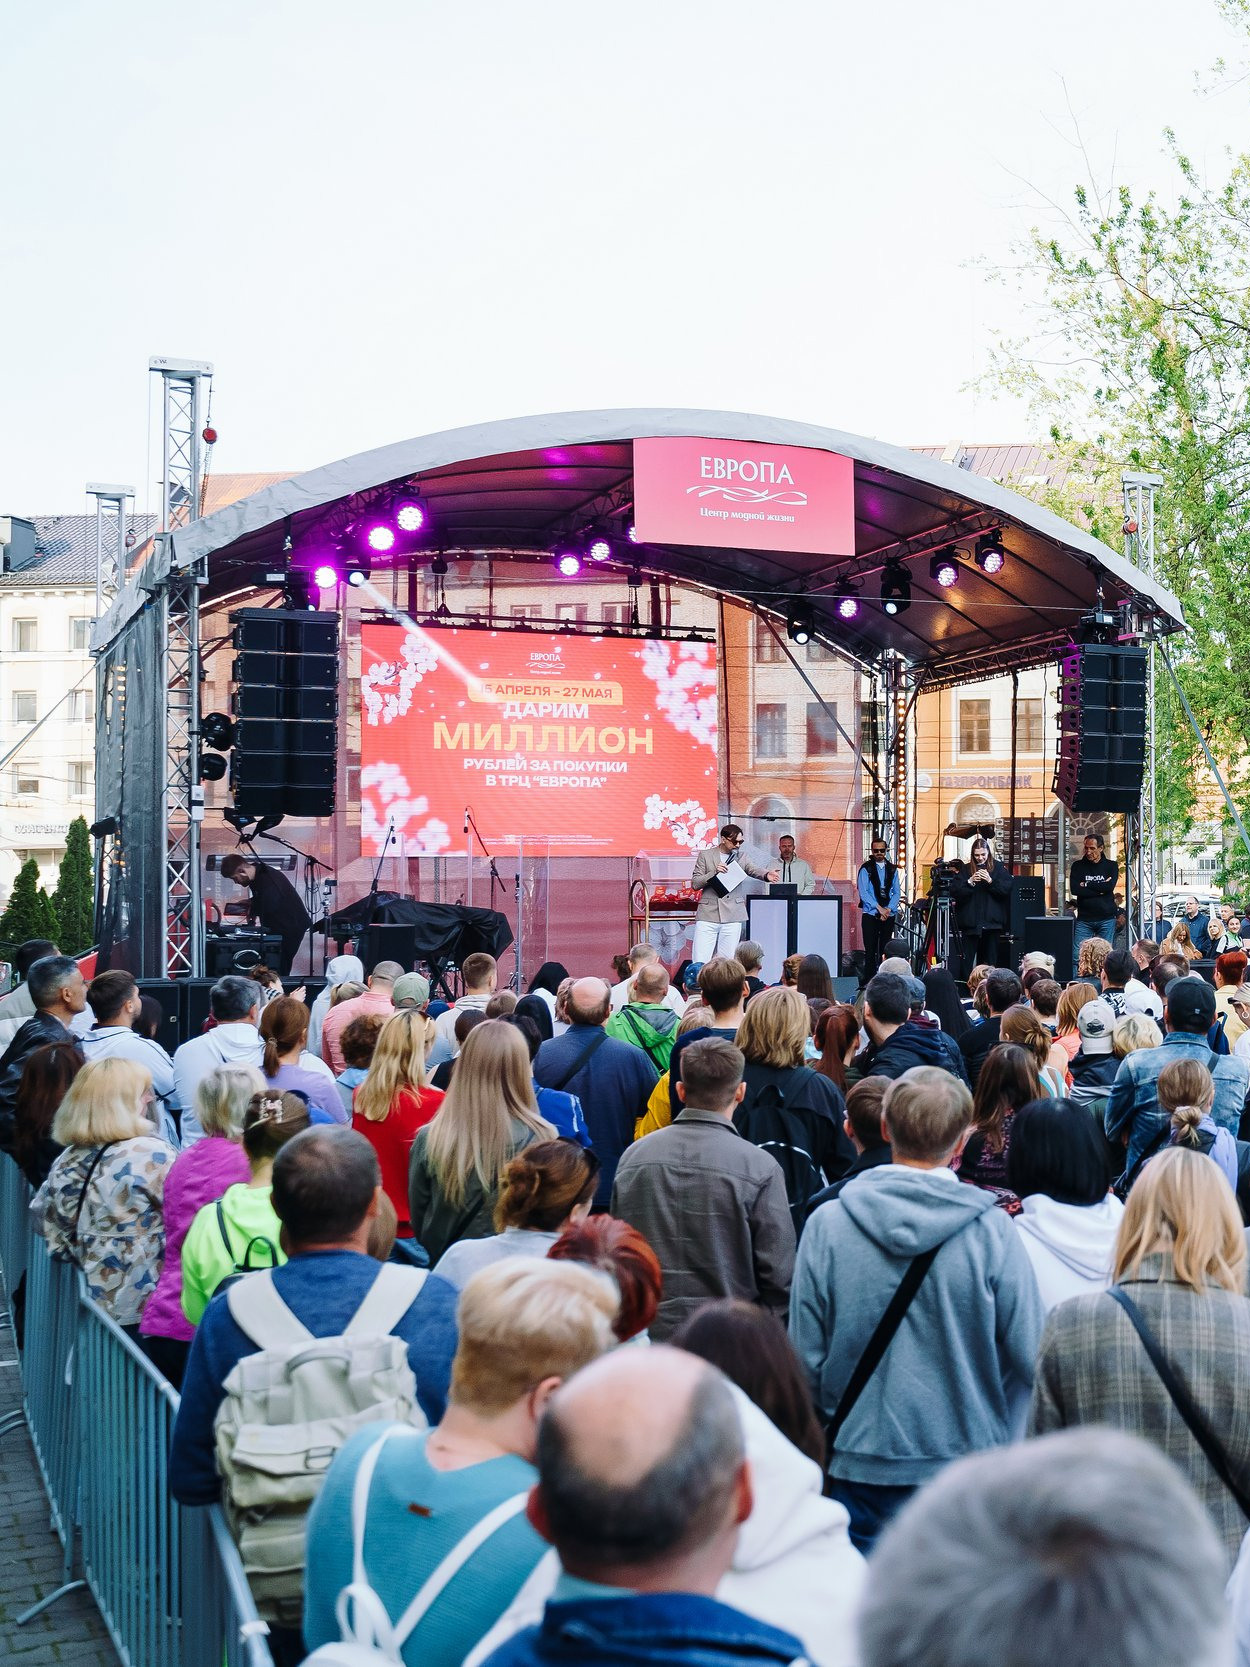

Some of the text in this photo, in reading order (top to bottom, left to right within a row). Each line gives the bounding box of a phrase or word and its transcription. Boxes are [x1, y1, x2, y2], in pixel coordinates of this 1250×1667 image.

[700, 456, 795, 485] ЕВРОПА
[700, 507, 795, 523] Центр модной жизни
[530, 652, 561, 662] ЕВРОПА
[496, 684, 550, 697] АПРЕЛЯ
[563, 687, 578, 697] 27
[582, 687, 612, 698] МАЯ
[503, 702, 589, 719] ДАРИМ
[433, 721, 653, 755] МИЛЛИОН
[463, 757, 628, 773] РУБЛЕЙ ЗА ПОКУПКИ
[486, 775, 496, 786] В
[499, 775, 531, 788] ТРЦ
